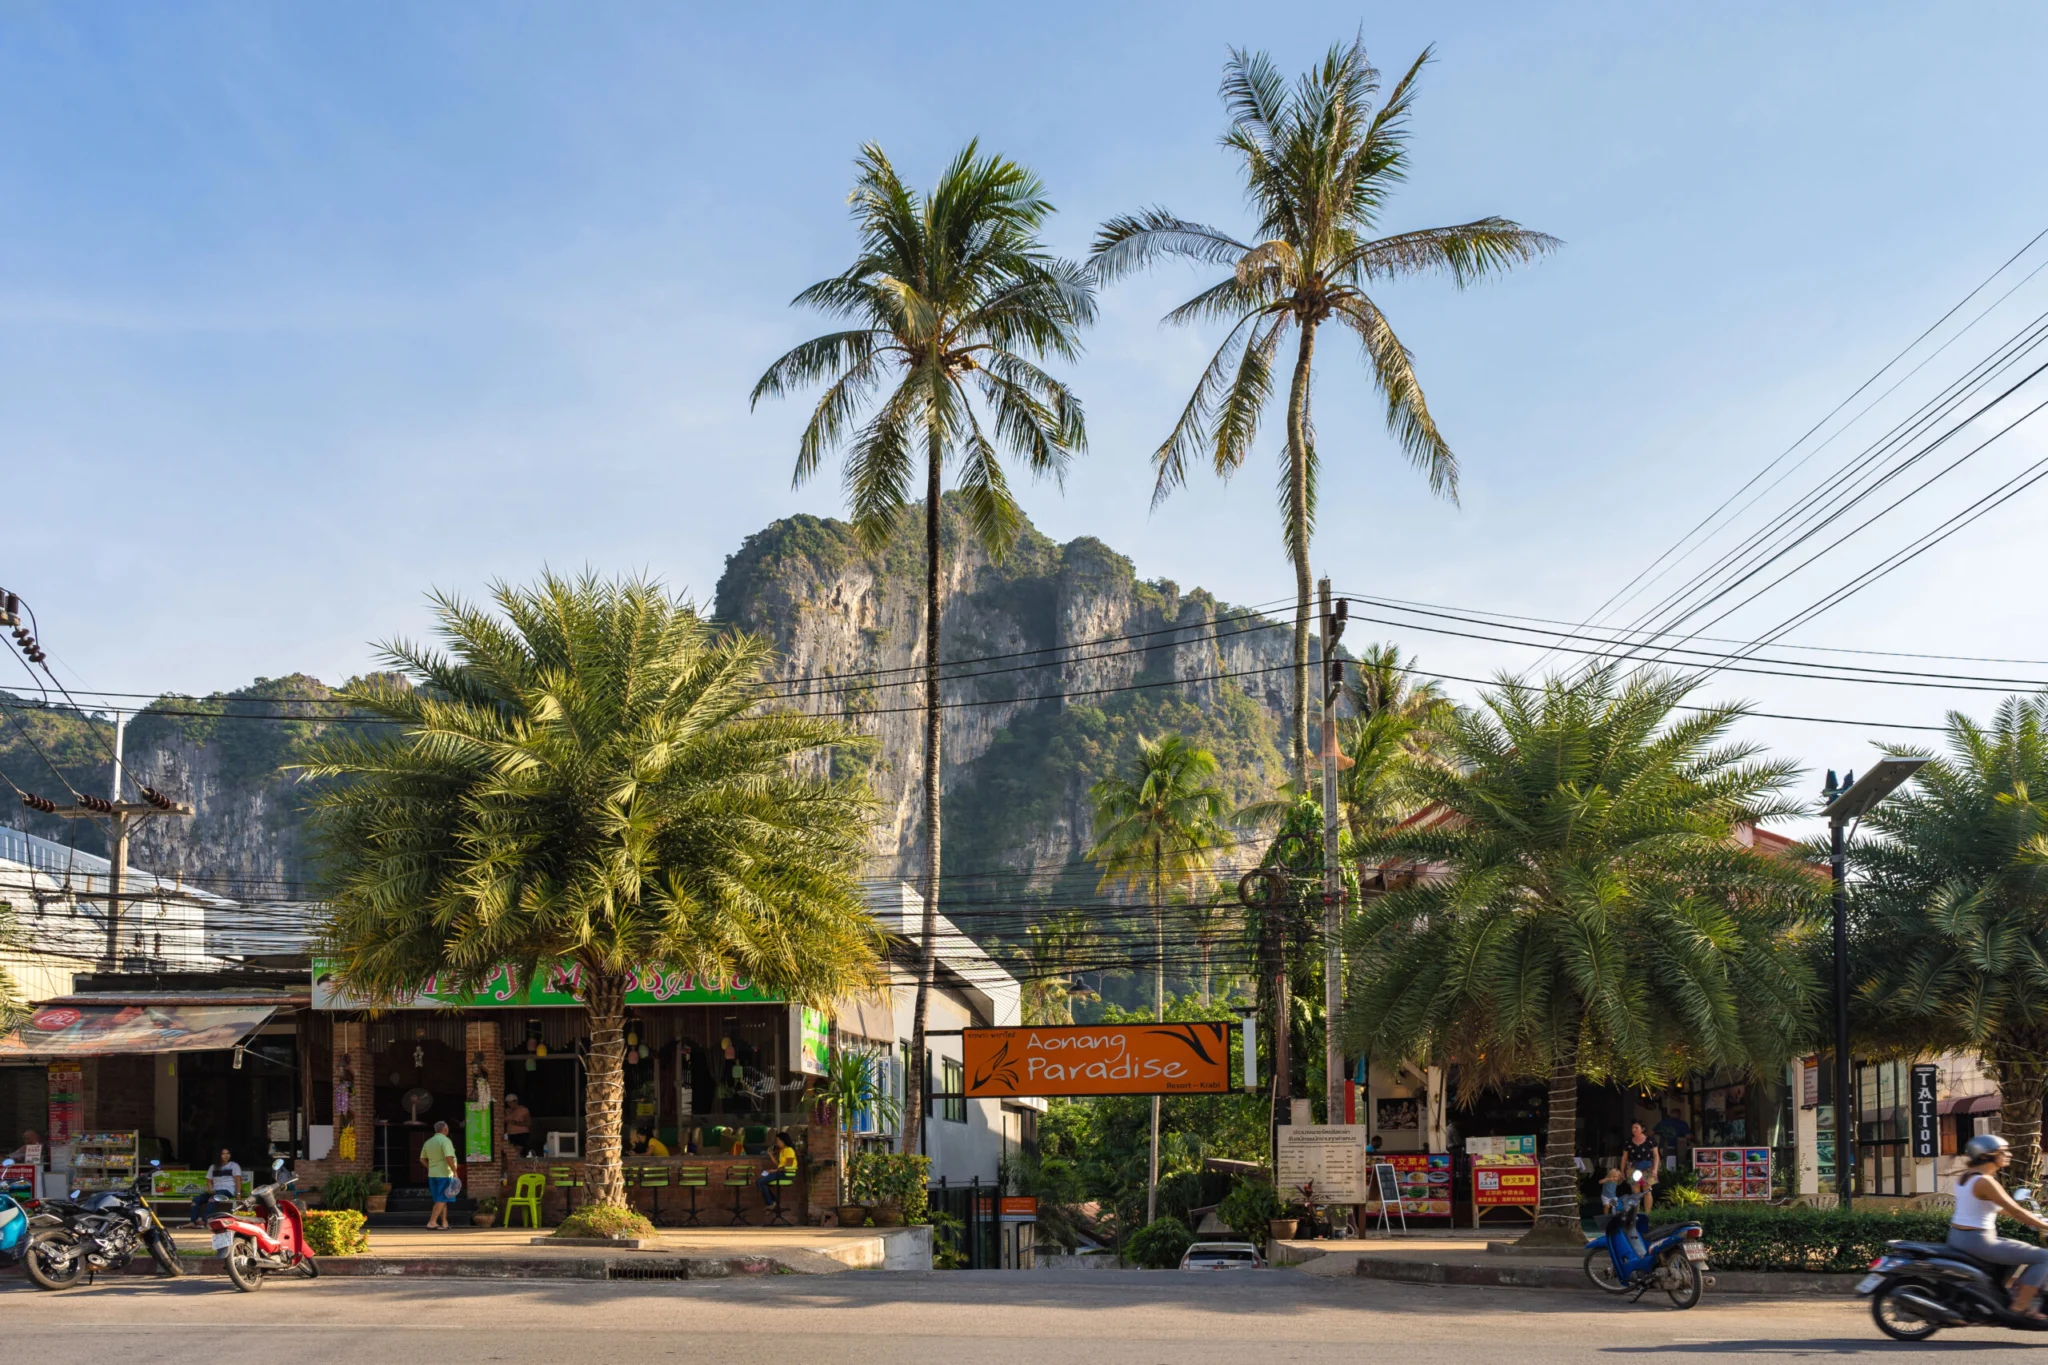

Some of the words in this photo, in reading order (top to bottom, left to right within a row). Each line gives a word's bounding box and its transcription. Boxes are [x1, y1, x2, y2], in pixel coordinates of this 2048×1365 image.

[1026, 1032, 1127, 1064] Aonang
[1027, 1053, 1188, 1081] Paradise
[1166, 1081, 1192, 1089] Resort
[1199, 1081, 1221, 1089] Krabi
[1917, 1072, 1934, 1156] TATTOO
[1387, 1157, 1428, 1166] 中文菜单
